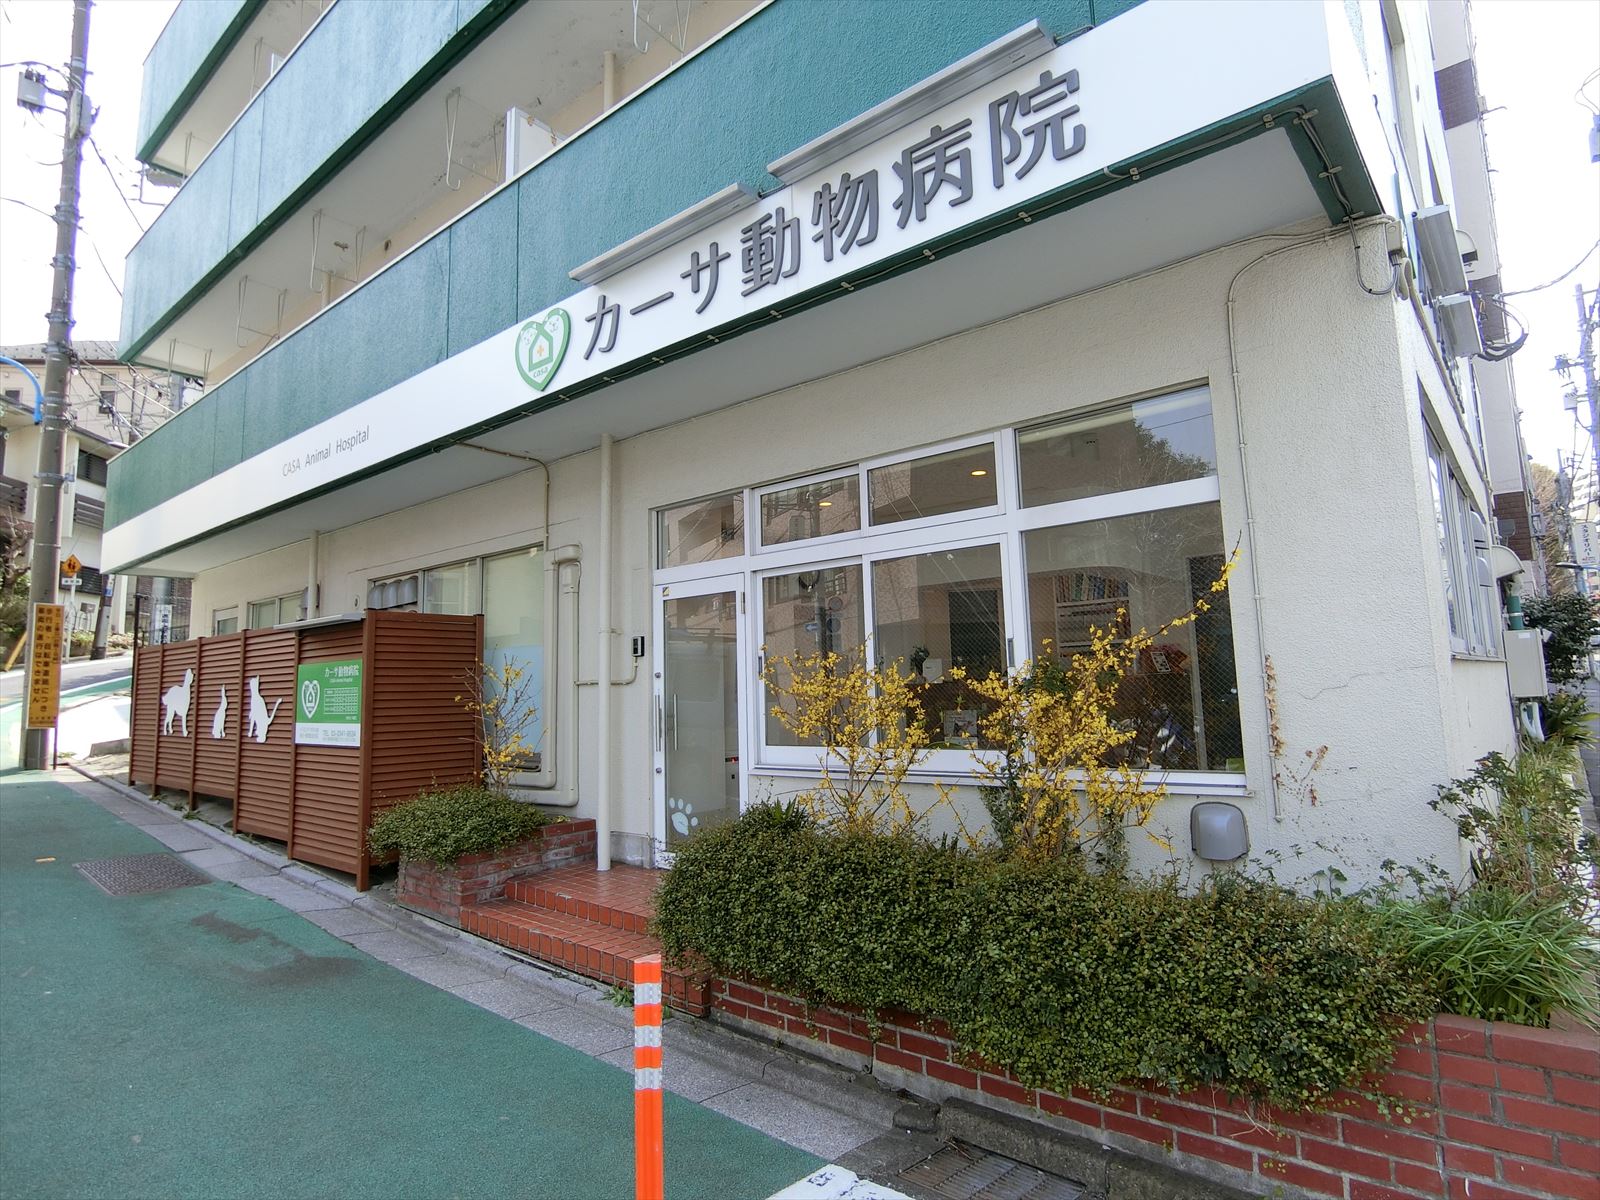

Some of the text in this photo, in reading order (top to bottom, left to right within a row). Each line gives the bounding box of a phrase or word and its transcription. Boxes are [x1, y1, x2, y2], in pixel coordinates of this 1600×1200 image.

[583, 68, 1088, 361] カーサ動物病院
[282, 425, 370, 477] CASA Animal Hospital
